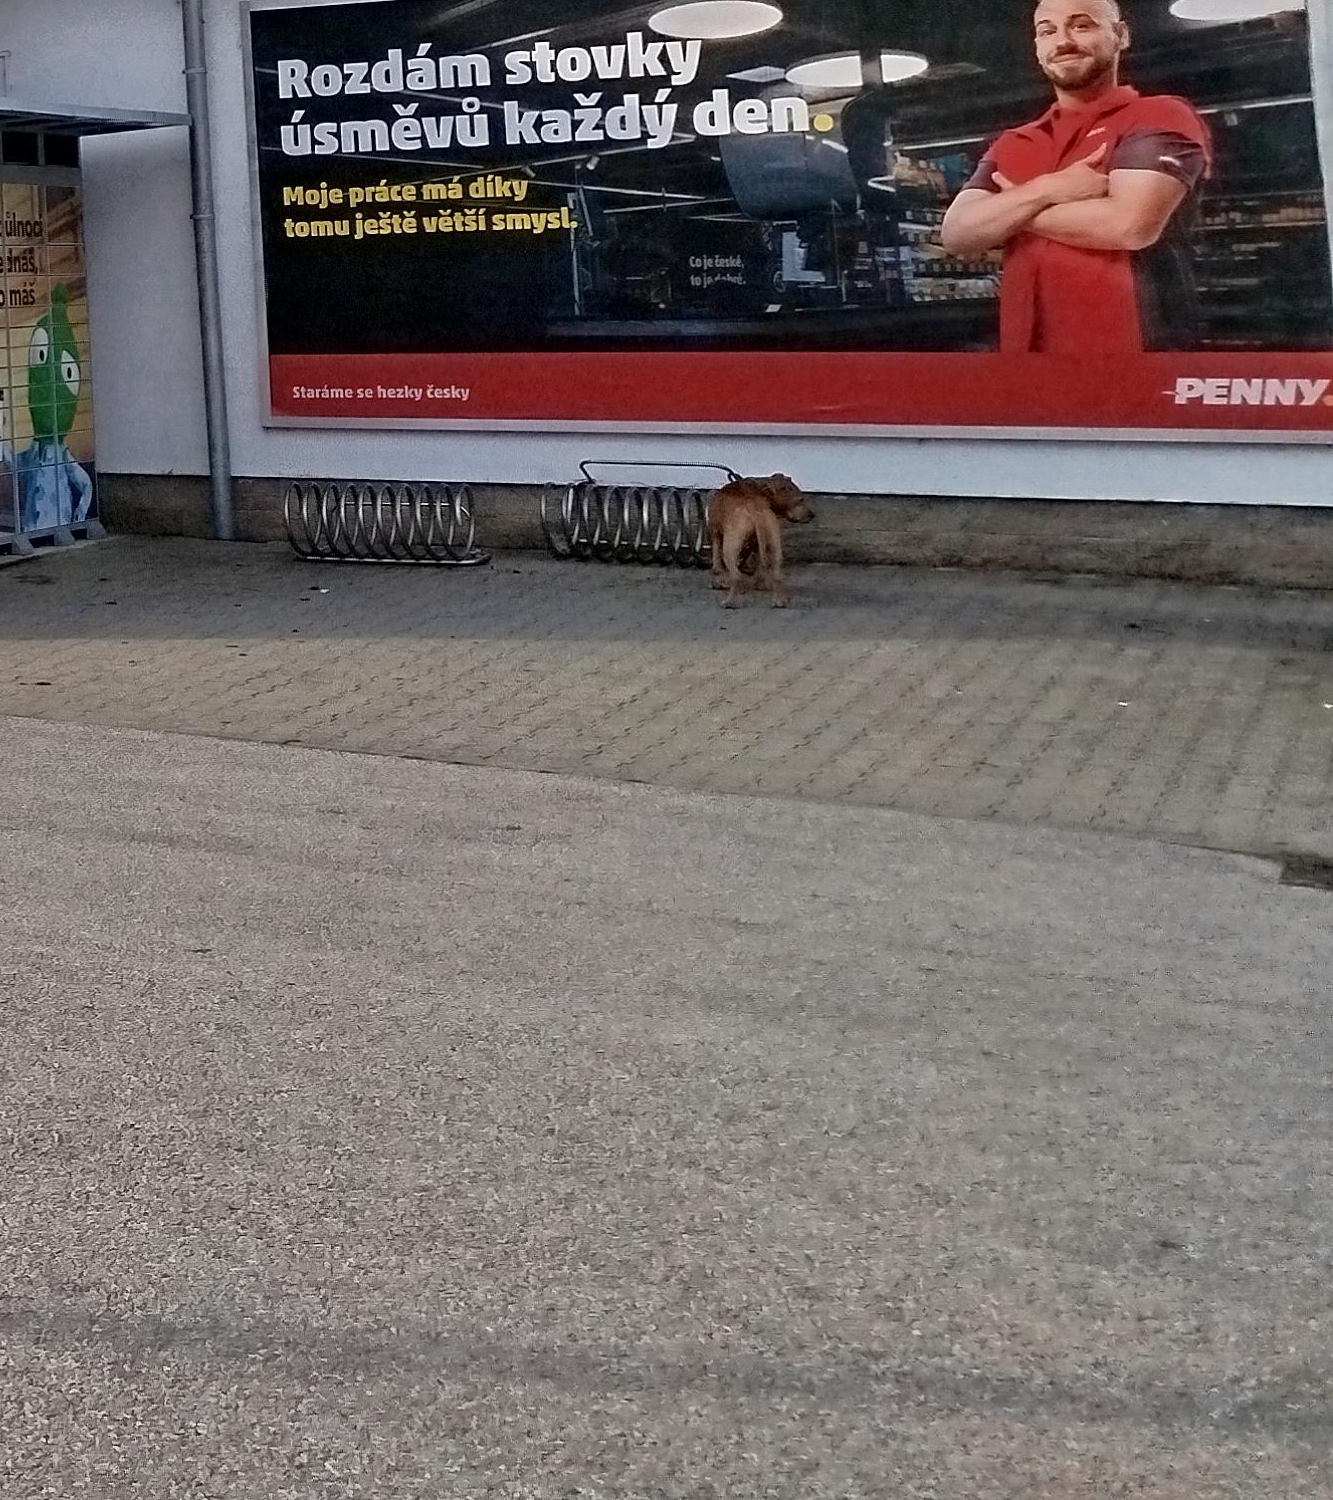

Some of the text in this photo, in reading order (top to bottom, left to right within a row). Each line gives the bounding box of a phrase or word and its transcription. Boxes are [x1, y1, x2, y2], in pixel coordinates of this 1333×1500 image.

[277, 32, 702, 100] Rozdám stovky
[280, 87, 834, 157] úsměvů každý den.
[283, 175, 528, 209] Moje práce má díky
[284, 205, 578, 240] tomu ještě větší smysl.
[689, 256, 702, 268] Co
[703, 254, 714, 270] je
[9, 282, 36, 306] máš
[690, 274, 702, 286] to
[292, 384, 470, 401] Staráme se hezky česky
